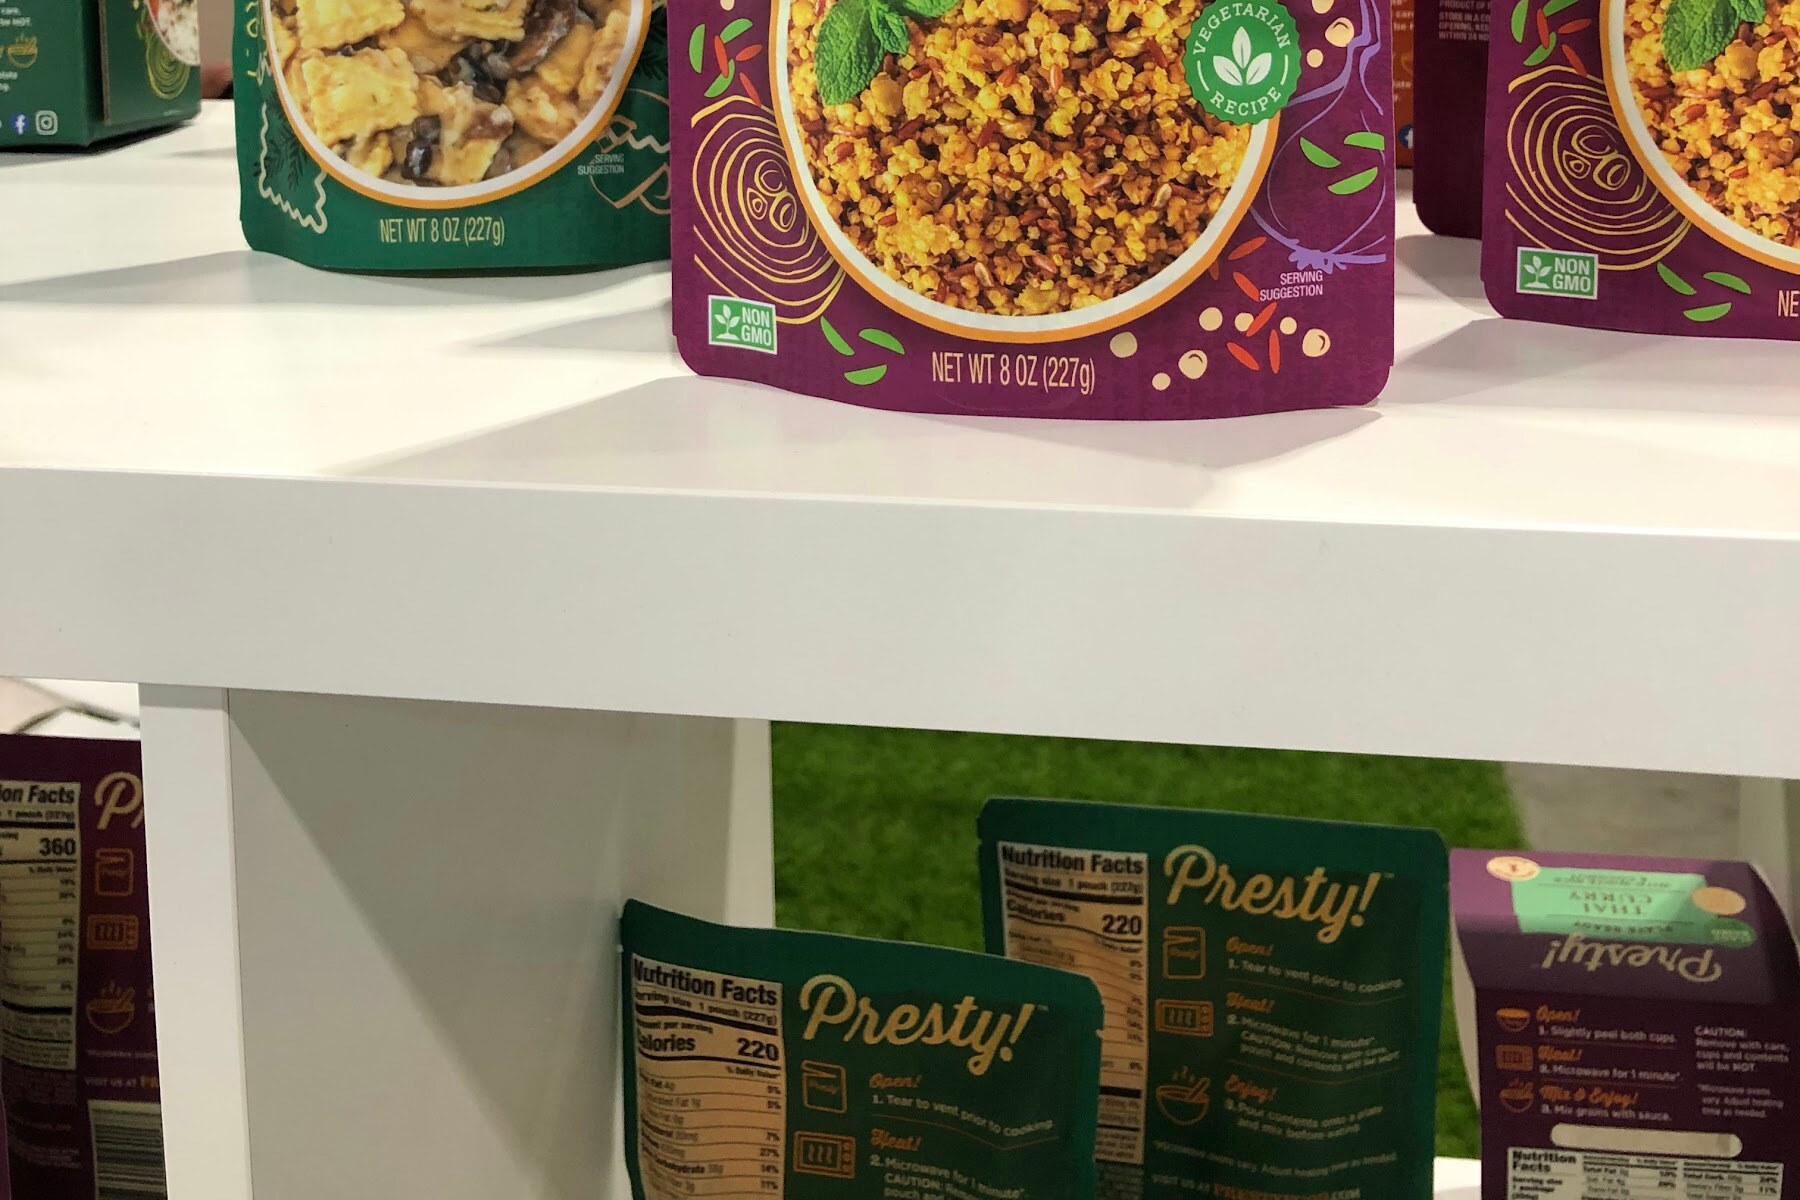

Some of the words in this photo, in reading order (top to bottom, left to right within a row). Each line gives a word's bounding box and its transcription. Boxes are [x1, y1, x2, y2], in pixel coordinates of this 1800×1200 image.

[1192, 2, 1292, 55] VEGETARIAN
[1210, 86, 1281, 117] RECIPE
[577, 163, 625, 176] SUGGESTION
[380, 218, 404, 243] NET
[406, 218, 427, 243] WT
[431, 218, 439, 242] 8
[442, 217, 461, 242] OZ
[464, 216, 505, 246] (227g)
[1554, 257, 1590, 275] NON
[1279, 270, 1323, 286] SERVING
[1552, 273, 1591, 292] GMO
[1259, 284, 1323, 302] SUGGESTION
[741, 307, 771, 329] NON
[740, 326, 772, 347] GMO
[932, 351, 964, 385] NET
[967, 352, 997, 385] WT
[1000, 354, 1010, 386] 8
[1015, 355, 1038, 387] OZ
[1043, 356, 1096, 395] (227g)
[39, 837, 76, 857] 360
[1002, 845, 1084, 872] Nutrition
[1092, 854, 1143, 875] Facts
[1164, 845, 1381, 943] Presty!
[1102, 914, 1141, 936] 220
[1542, 932, 1722, 982] Presty!
[722, 979, 777, 1006] Facts
[800, 974, 1035, 1076] Presty!
[737, 1036, 779, 1062] 220
[1512, 1150, 1577, 1164] Nutrition
[1512, 1160, 1552, 1173] Facts
